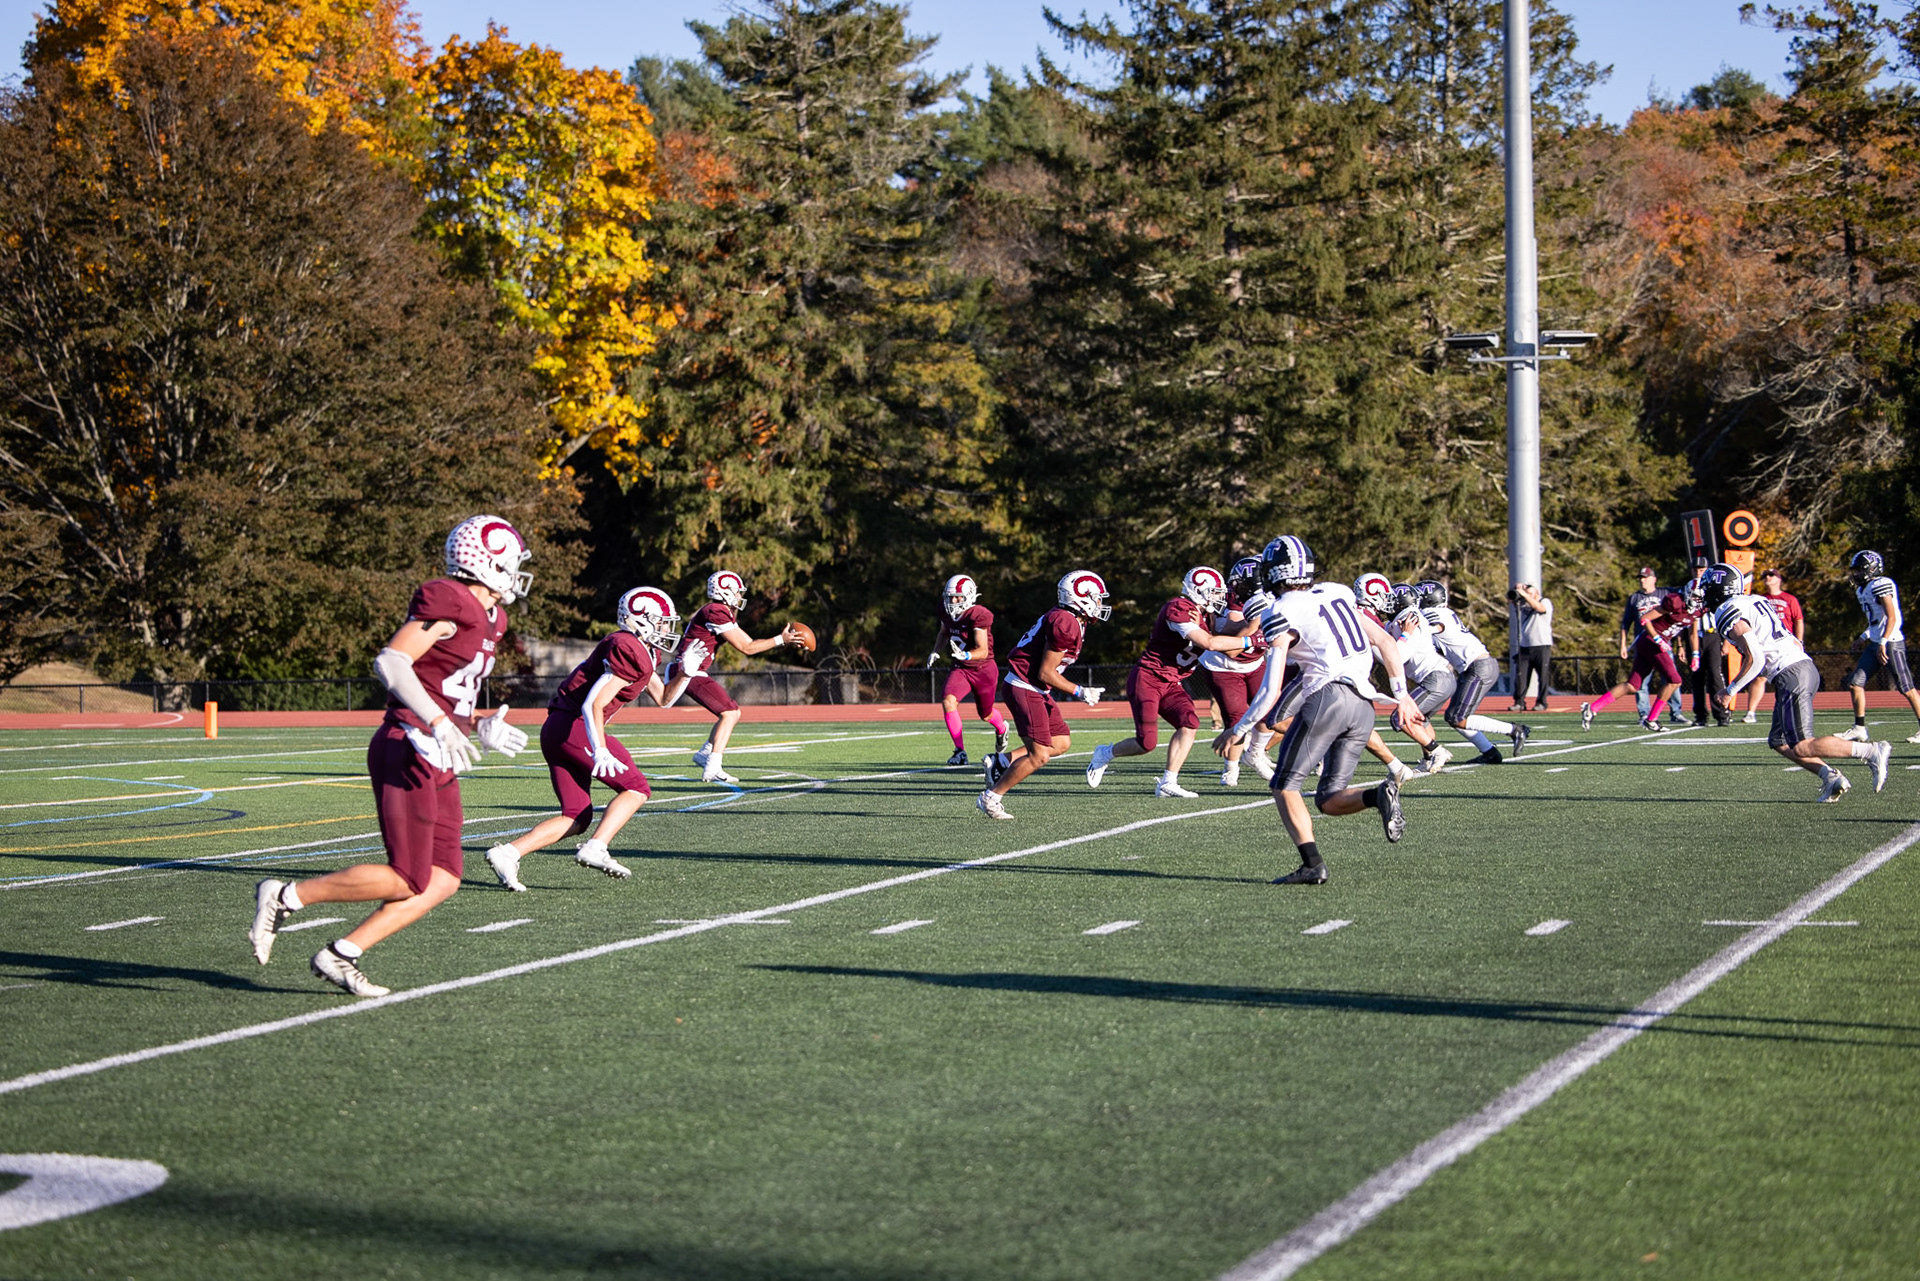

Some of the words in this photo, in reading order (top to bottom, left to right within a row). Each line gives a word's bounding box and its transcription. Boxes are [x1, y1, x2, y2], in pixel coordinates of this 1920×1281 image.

[1690, 517, 1704, 547] 1
[1235, 562, 1257, 578] VT
[1701, 568, 1727, 584] VT
[1285, 577, 1312, 585] Riddell
[1318, 598, 1367, 658] 10
